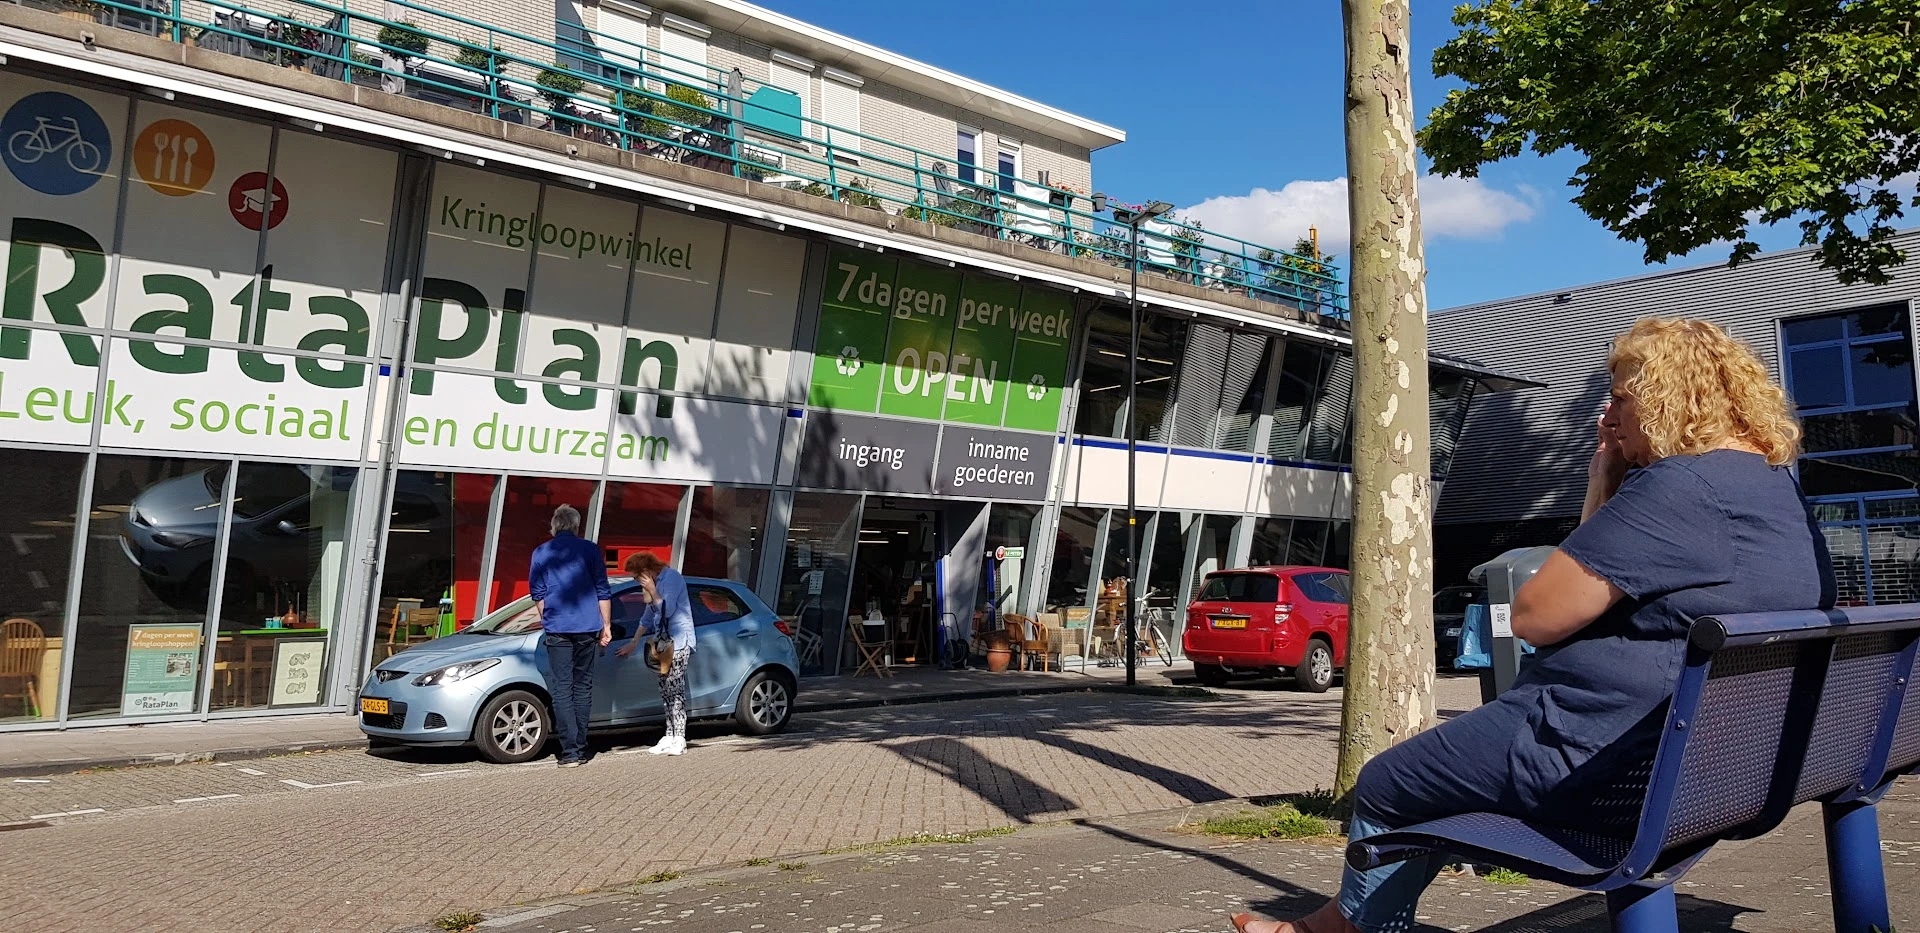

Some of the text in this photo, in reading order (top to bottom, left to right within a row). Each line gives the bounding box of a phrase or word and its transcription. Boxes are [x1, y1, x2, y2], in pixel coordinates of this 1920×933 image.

[440, 195, 693, 270] Kringloopwinkel
[958, 297, 1003, 328] per
[1008, 309, 1071, 339] week
[892, 347, 998, 405] OPEN
[0, 371, 669, 462] Leuk, sociaal en duurzaam
[839, 438, 905, 470] ingang
[968, 437, 1029, 462] inname
[953, 464, 1035, 486] goederen
[133, 629, 142, 641] 7
[142, 700, 179, 709] RataPlan
[362, 699, 387, 713] 24-GLS-5
